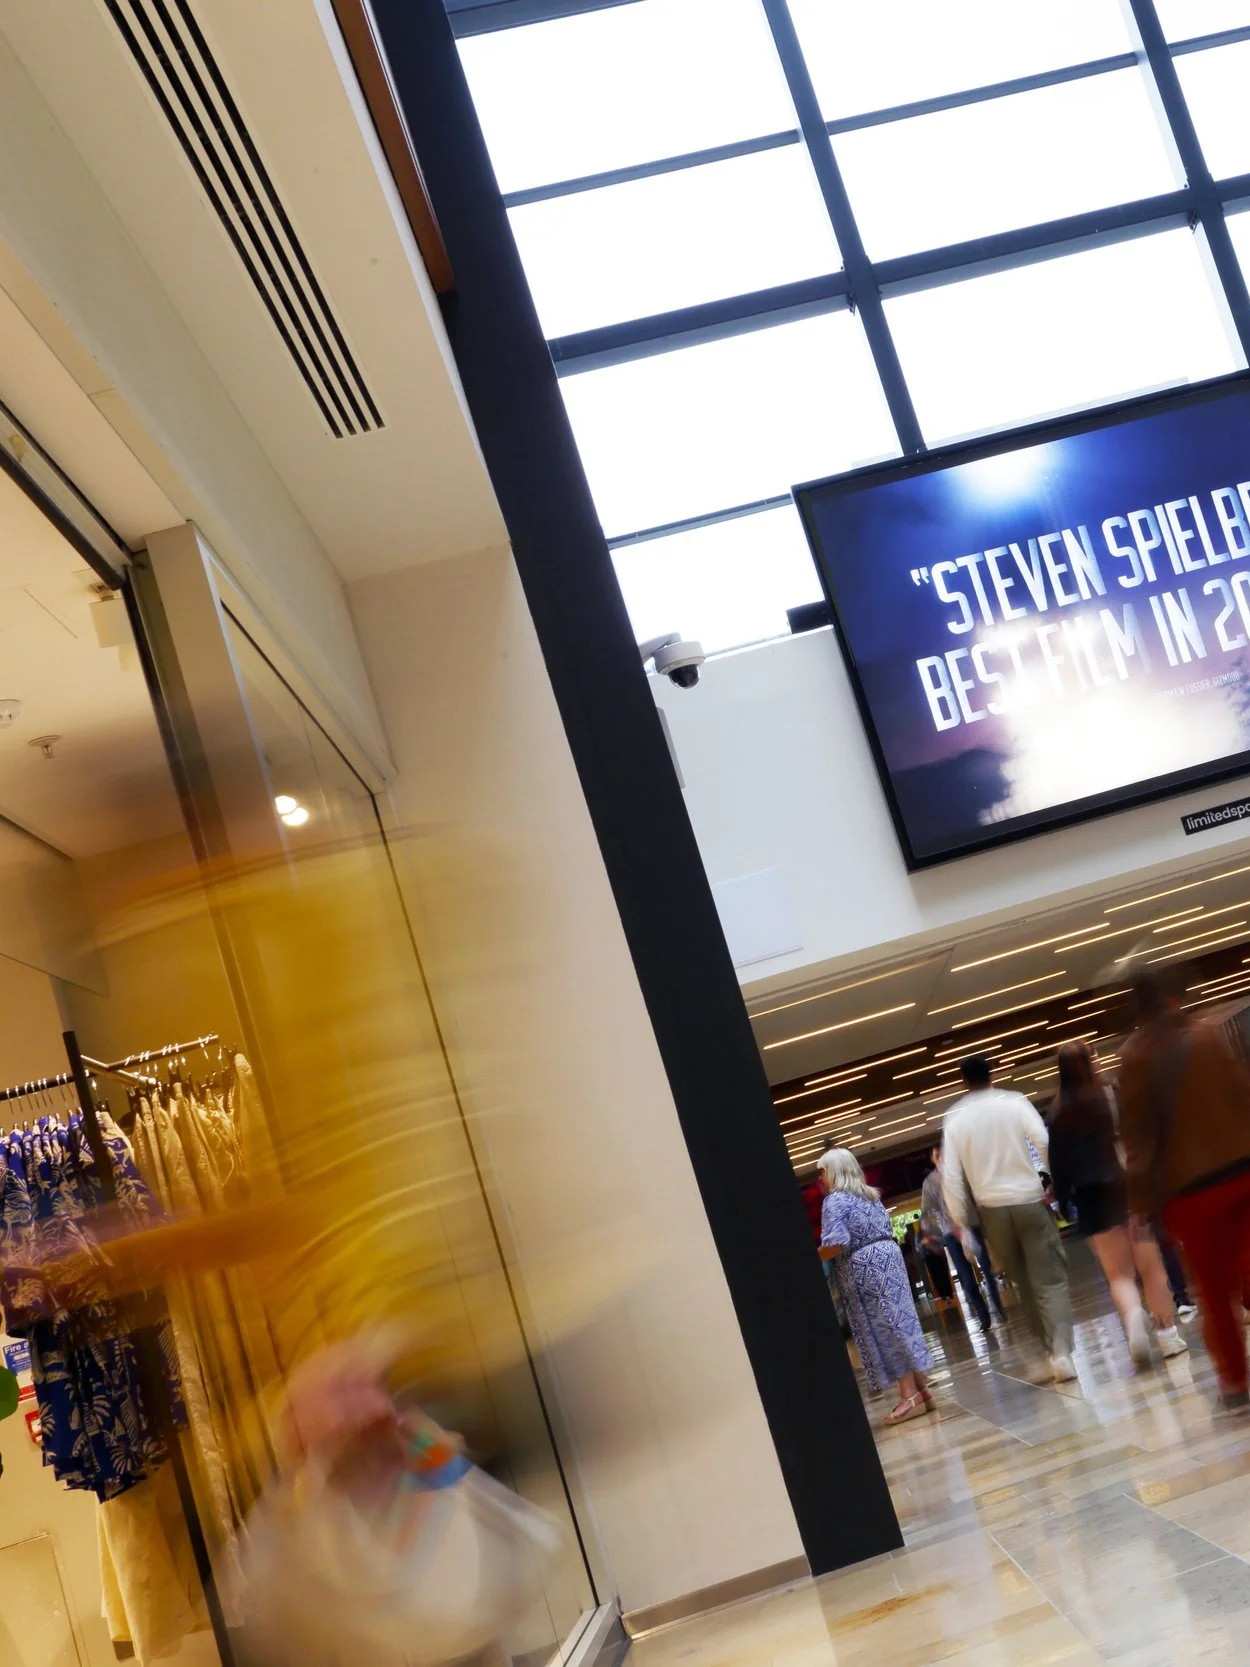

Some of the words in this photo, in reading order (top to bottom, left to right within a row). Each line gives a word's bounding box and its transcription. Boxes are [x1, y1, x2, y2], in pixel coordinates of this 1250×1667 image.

[910, 524, 1107, 634] “STEVEN
[915, 632, 1035, 732] BEST
[1037, 602, 1153, 699] FILM
[1149, 588, 1207, 667] IN
[4, 1344, 22, 1354] Fire
